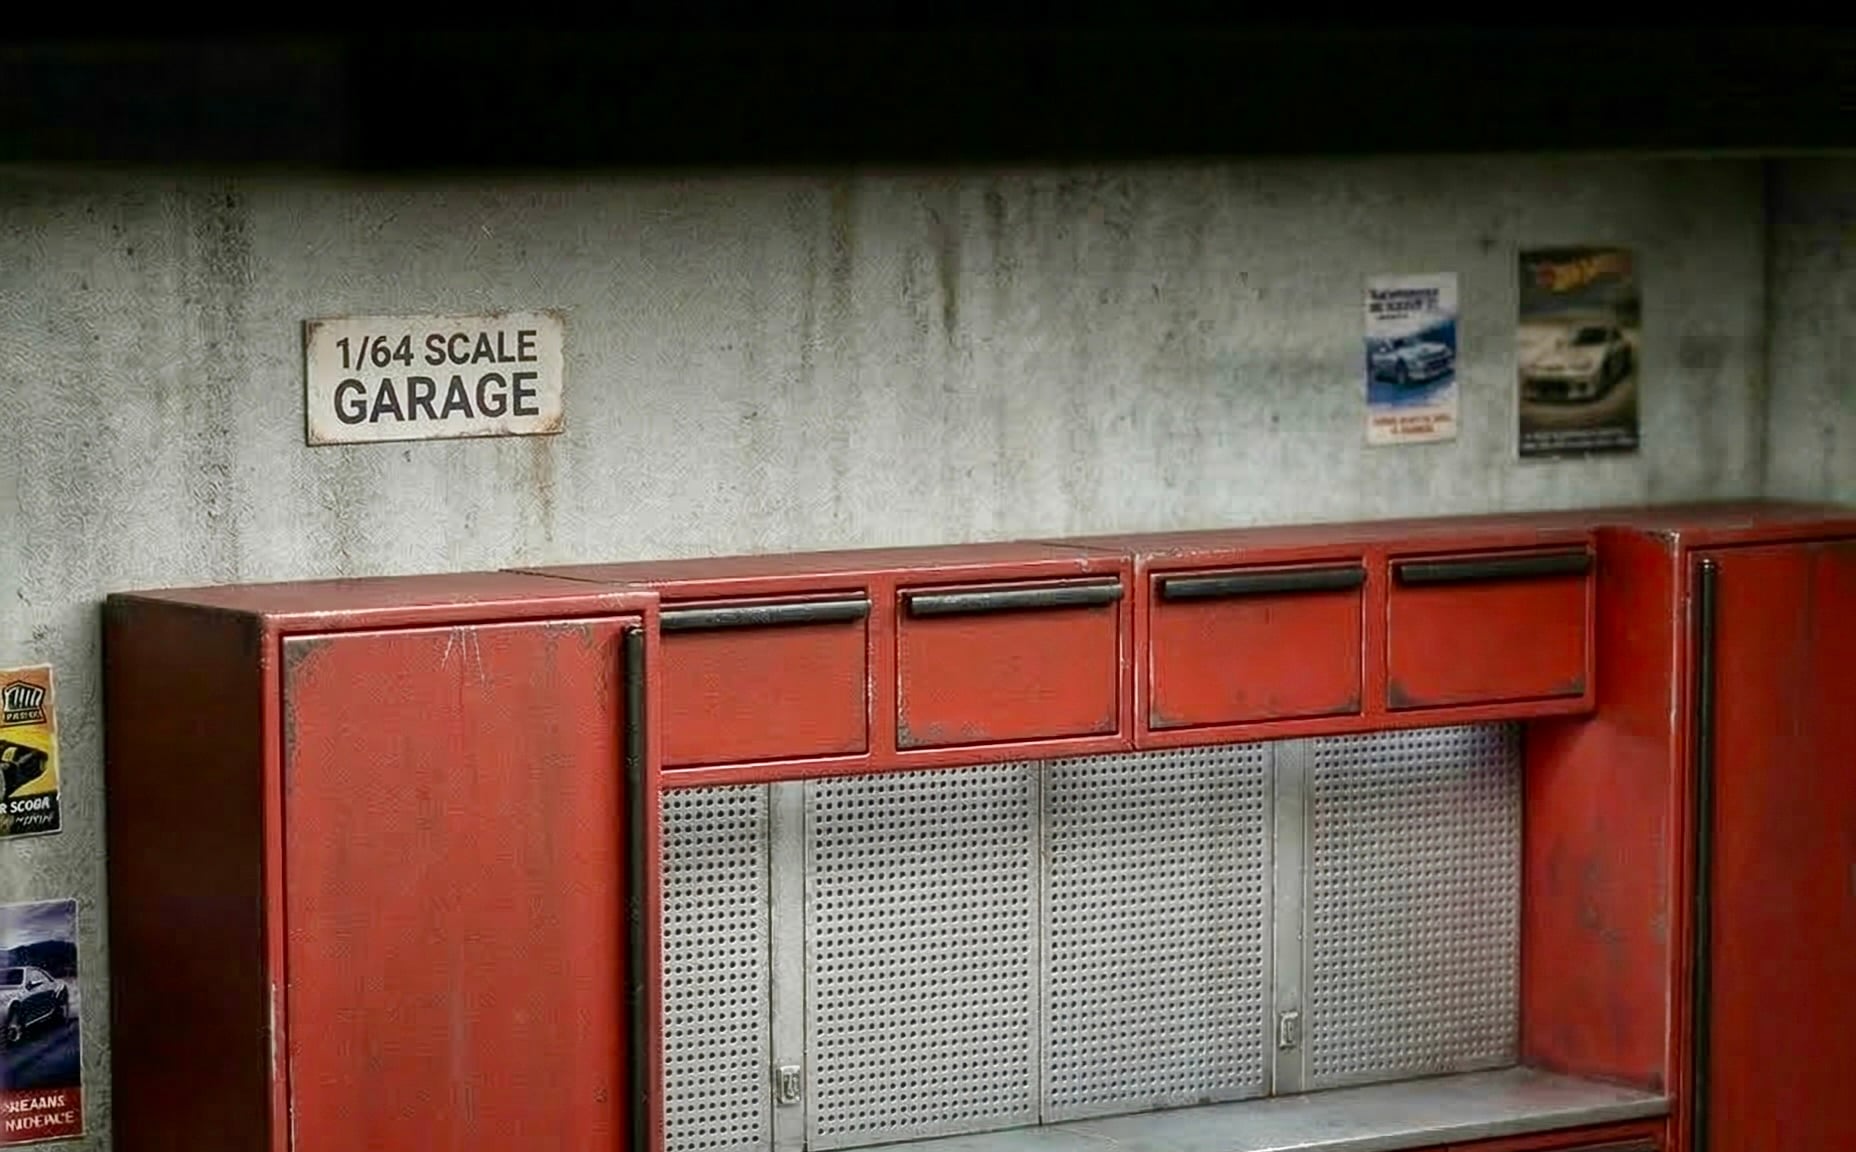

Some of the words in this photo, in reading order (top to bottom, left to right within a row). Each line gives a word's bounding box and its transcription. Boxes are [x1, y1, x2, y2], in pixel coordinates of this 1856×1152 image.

[336, 335, 414, 371] 1/64
[425, 330, 537, 366] SCALE
[334, 372, 539, 425] GARAGE
